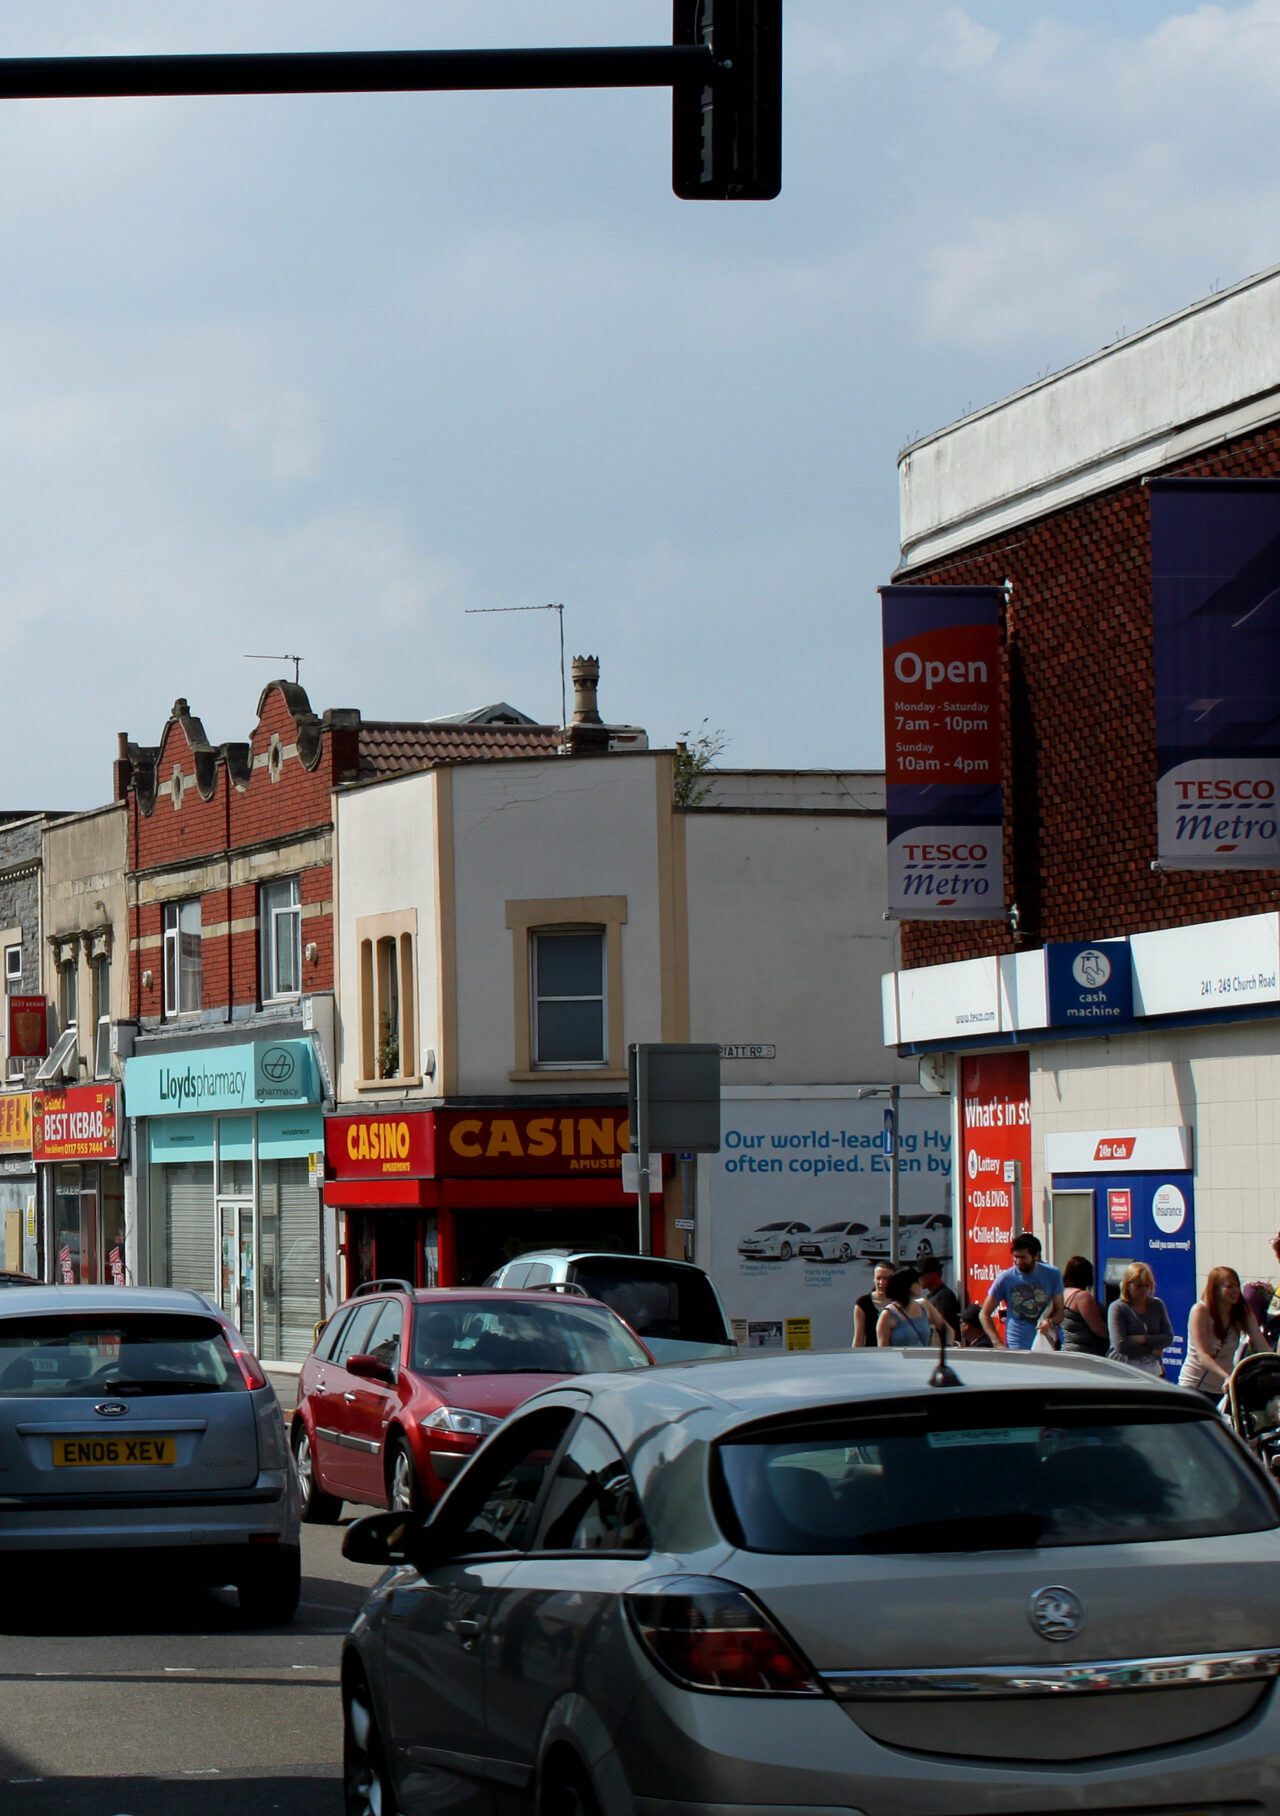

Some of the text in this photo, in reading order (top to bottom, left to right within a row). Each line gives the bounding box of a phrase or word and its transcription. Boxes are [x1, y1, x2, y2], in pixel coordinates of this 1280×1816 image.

[894, 651, 988, 691] Open
[895, 702, 935, 713] Monday
[943, 702, 989, 713] Saturday
[894, 716, 930, 731] 7am
[944, 716, 988, 734] 10pm
[896, 742, 934, 753] Sunday
[897, 756, 940, 770] 10am
[954, 755, 989, 773] 4pm
[1174, 780, 1275, 800] TESCO
[1175, 815, 1277, 840] Metro
[902, 844, 988, 861] TESCO
[903, 873, 989, 895] Metro
[1232, 975, 1257, 991] Church
[1258, 971, 1276, 988] Road
[1079, 992, 1107, 1003] cash
[1067, 1006, 1121, 1017] machine
[159, 1065, 247, 1108] Lloydspharmacy
[256, 1087, 299, 1099] pharmacy
[965, 1096, 1032, 1128] What's in st
[44, 1111, 103, 1141] BEST KEBAB
[347, 1121, 410, 1160] CASINO
[725, 1130, 765, 1148] Our
[770, 1130, 918, 1152] world-leadng
[1113, 1144, 1127, 1157] Cash
[570, 1159, 622, 1169] AMUSE
[725, 1154, 783, 1172] often
[788, 1154, 864, 1177] copied.
[927, 1153, 952, 1176] by
[978, 1156, 1000, 1175] Lottery
[973, 1190, 985, 1208] CDs
[64, 1441, 166, 1462] EN06 XEV
